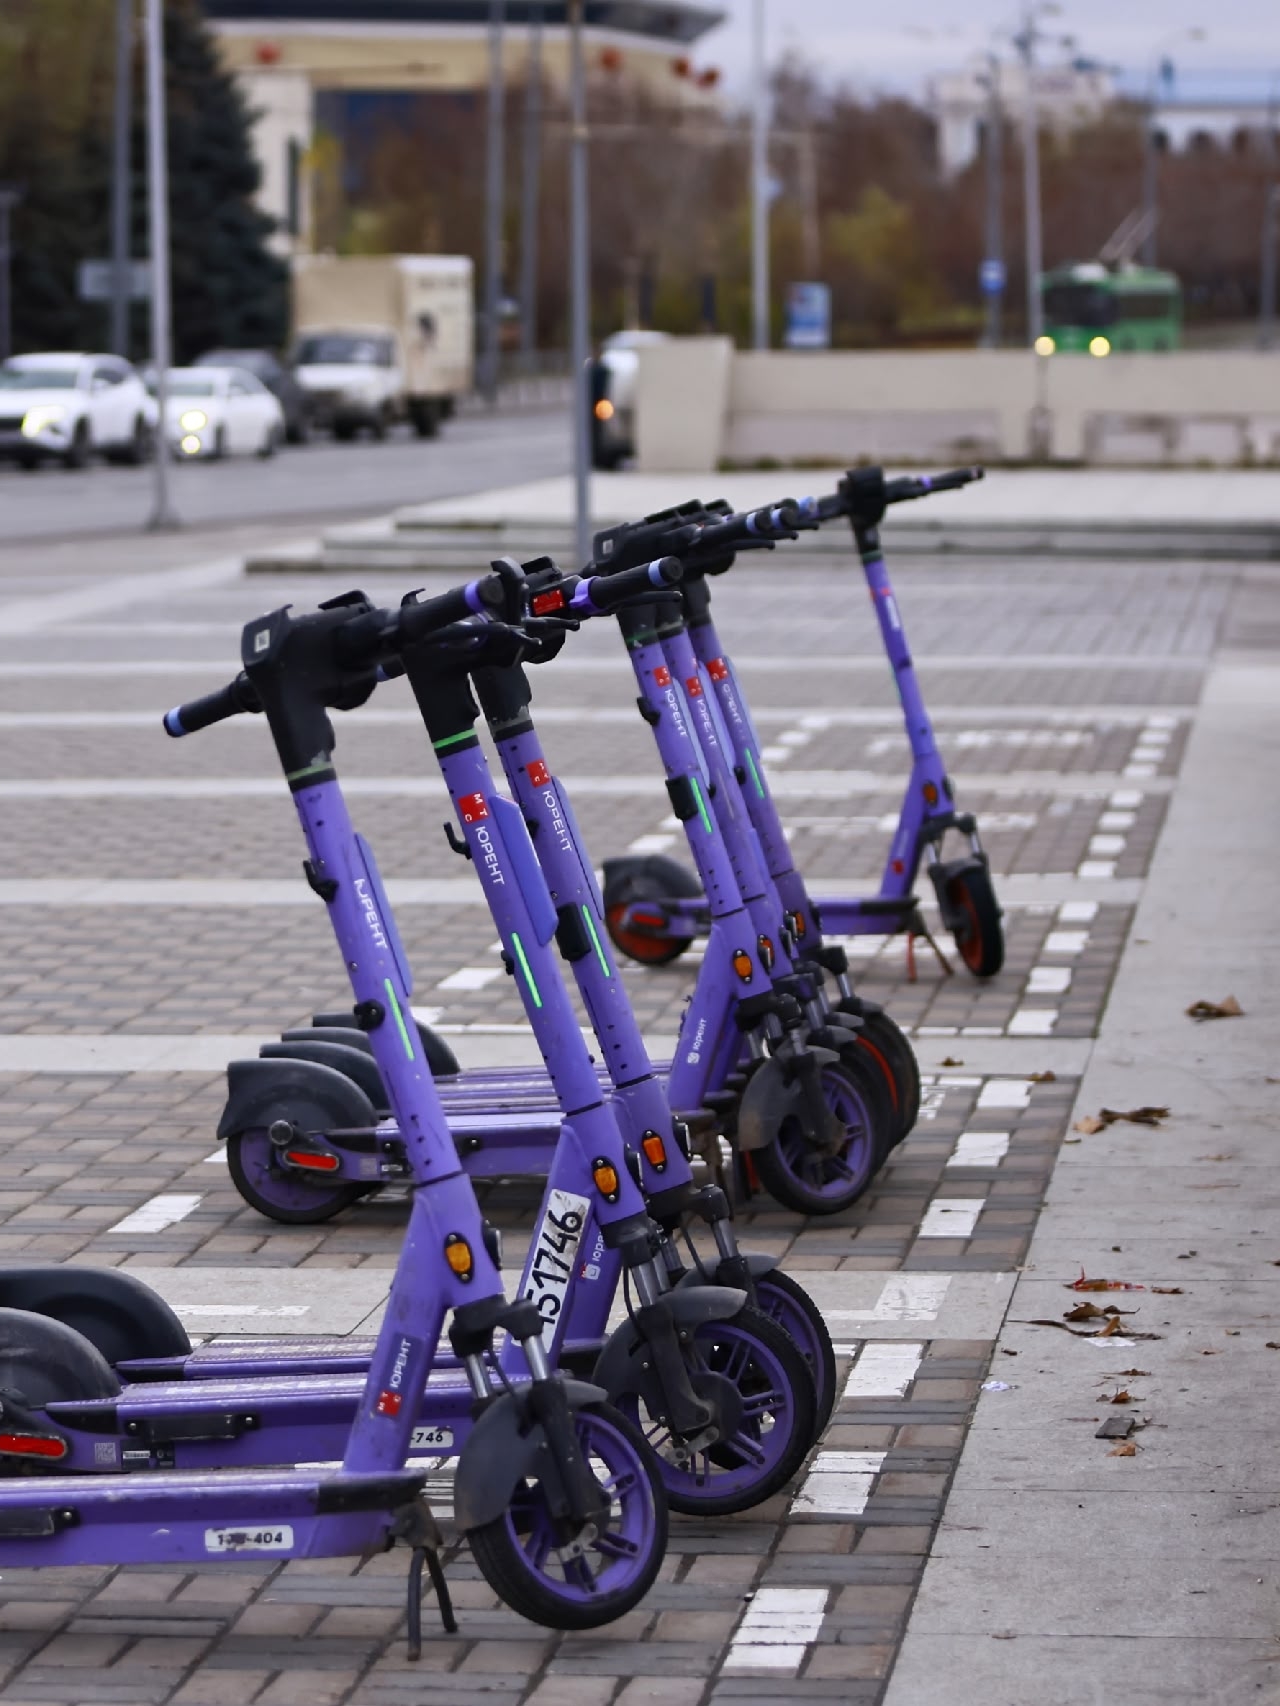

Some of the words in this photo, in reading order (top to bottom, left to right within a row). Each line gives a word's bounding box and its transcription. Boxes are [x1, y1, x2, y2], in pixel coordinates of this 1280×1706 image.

[542, 790, 572, 851] ЮРЕНТ
[475, 826, 505, 885] ЮРЕНТ
[389, 1338, 411, 1388] ЮРЕНТ
